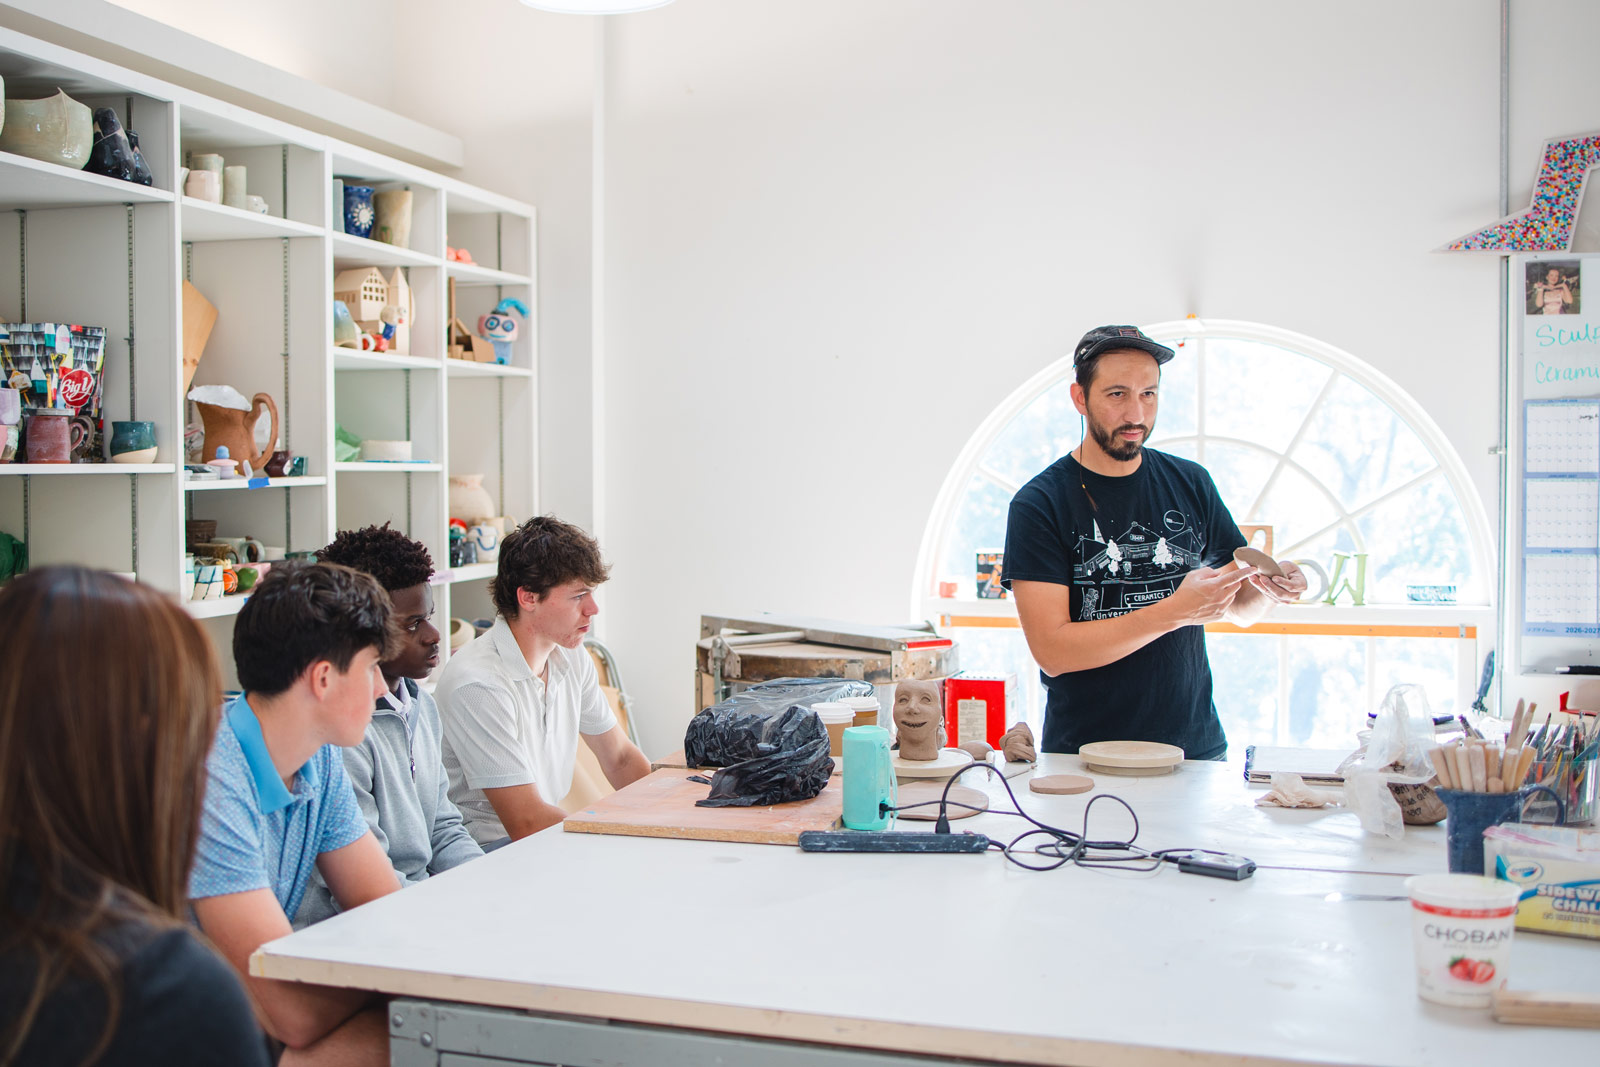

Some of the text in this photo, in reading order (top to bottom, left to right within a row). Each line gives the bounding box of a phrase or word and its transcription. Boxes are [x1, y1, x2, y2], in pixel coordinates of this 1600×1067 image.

[61, 379, 81, 398] Big
[1133, 592, 1165, 602] CERAMICS
[1423, 924, 1511, 944] CHOBAN
